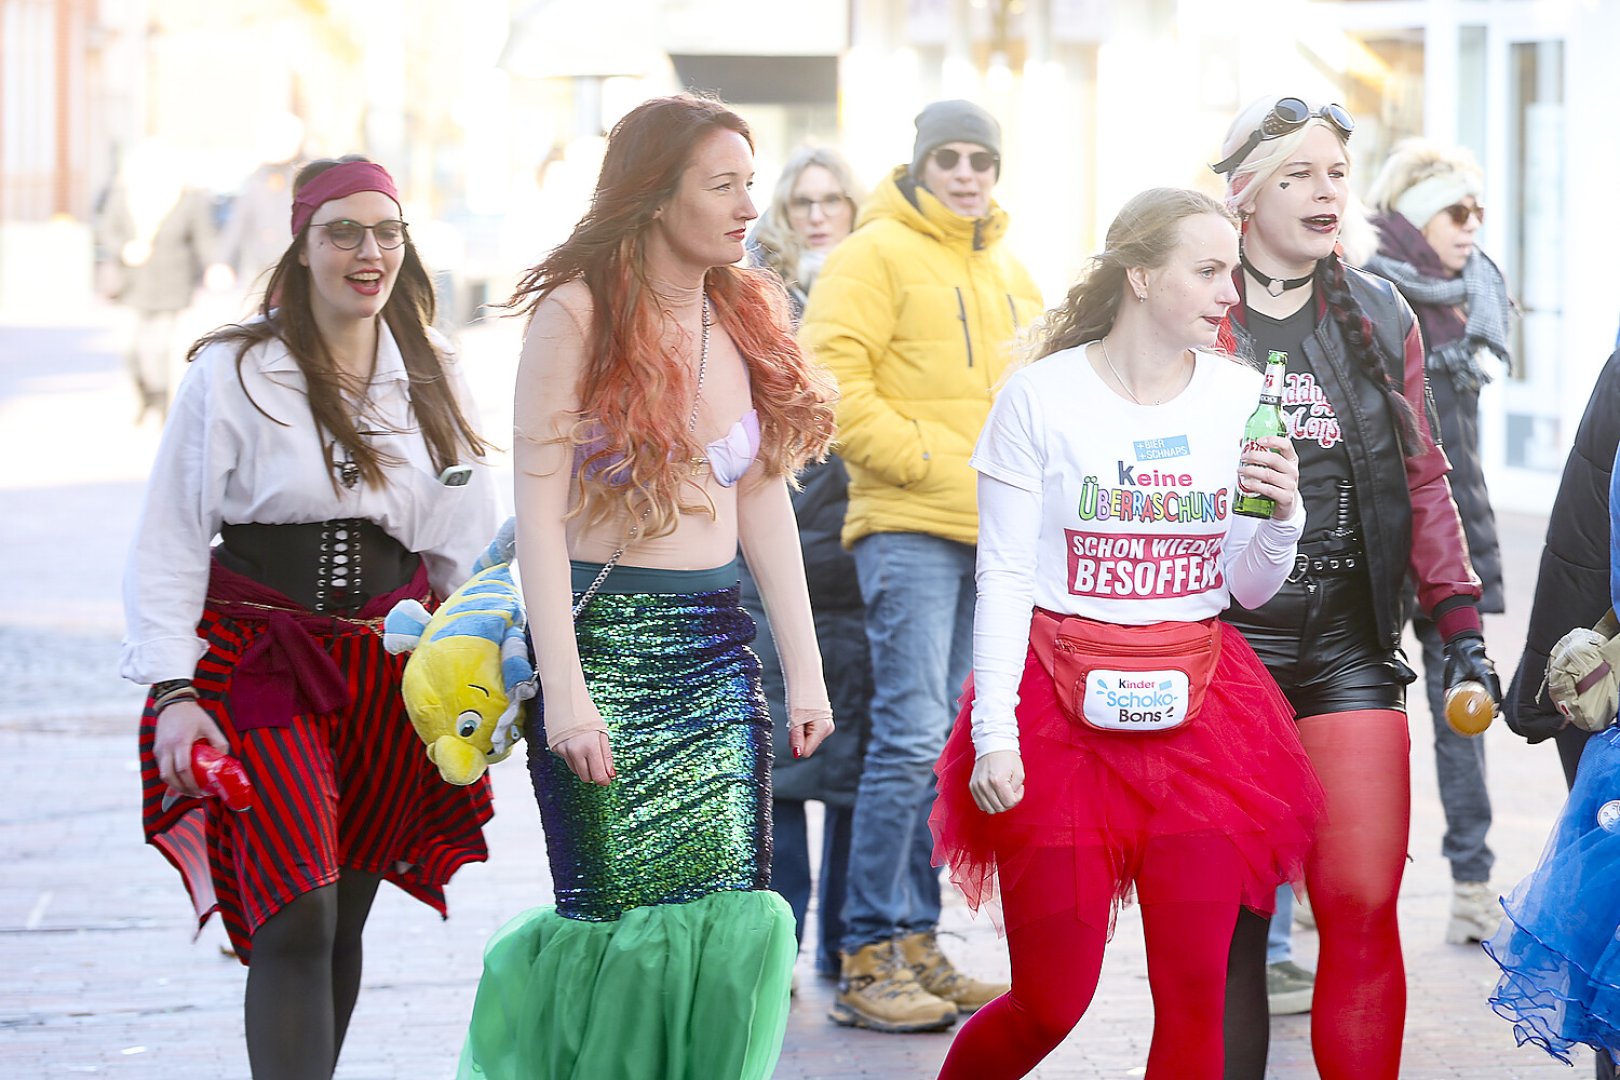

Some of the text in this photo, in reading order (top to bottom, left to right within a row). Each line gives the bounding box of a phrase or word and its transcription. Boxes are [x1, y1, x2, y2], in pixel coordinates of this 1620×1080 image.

[1078, 475, 1228, 523] ÜBERRASCHUNG
[1073, 535, 1145, 559] SCHON
[1073, 556, 1223, 596] BESOFFEN
[1106, 691, 1178, 708] Schoko-
[1118, 708, 1162, 723] Bons
